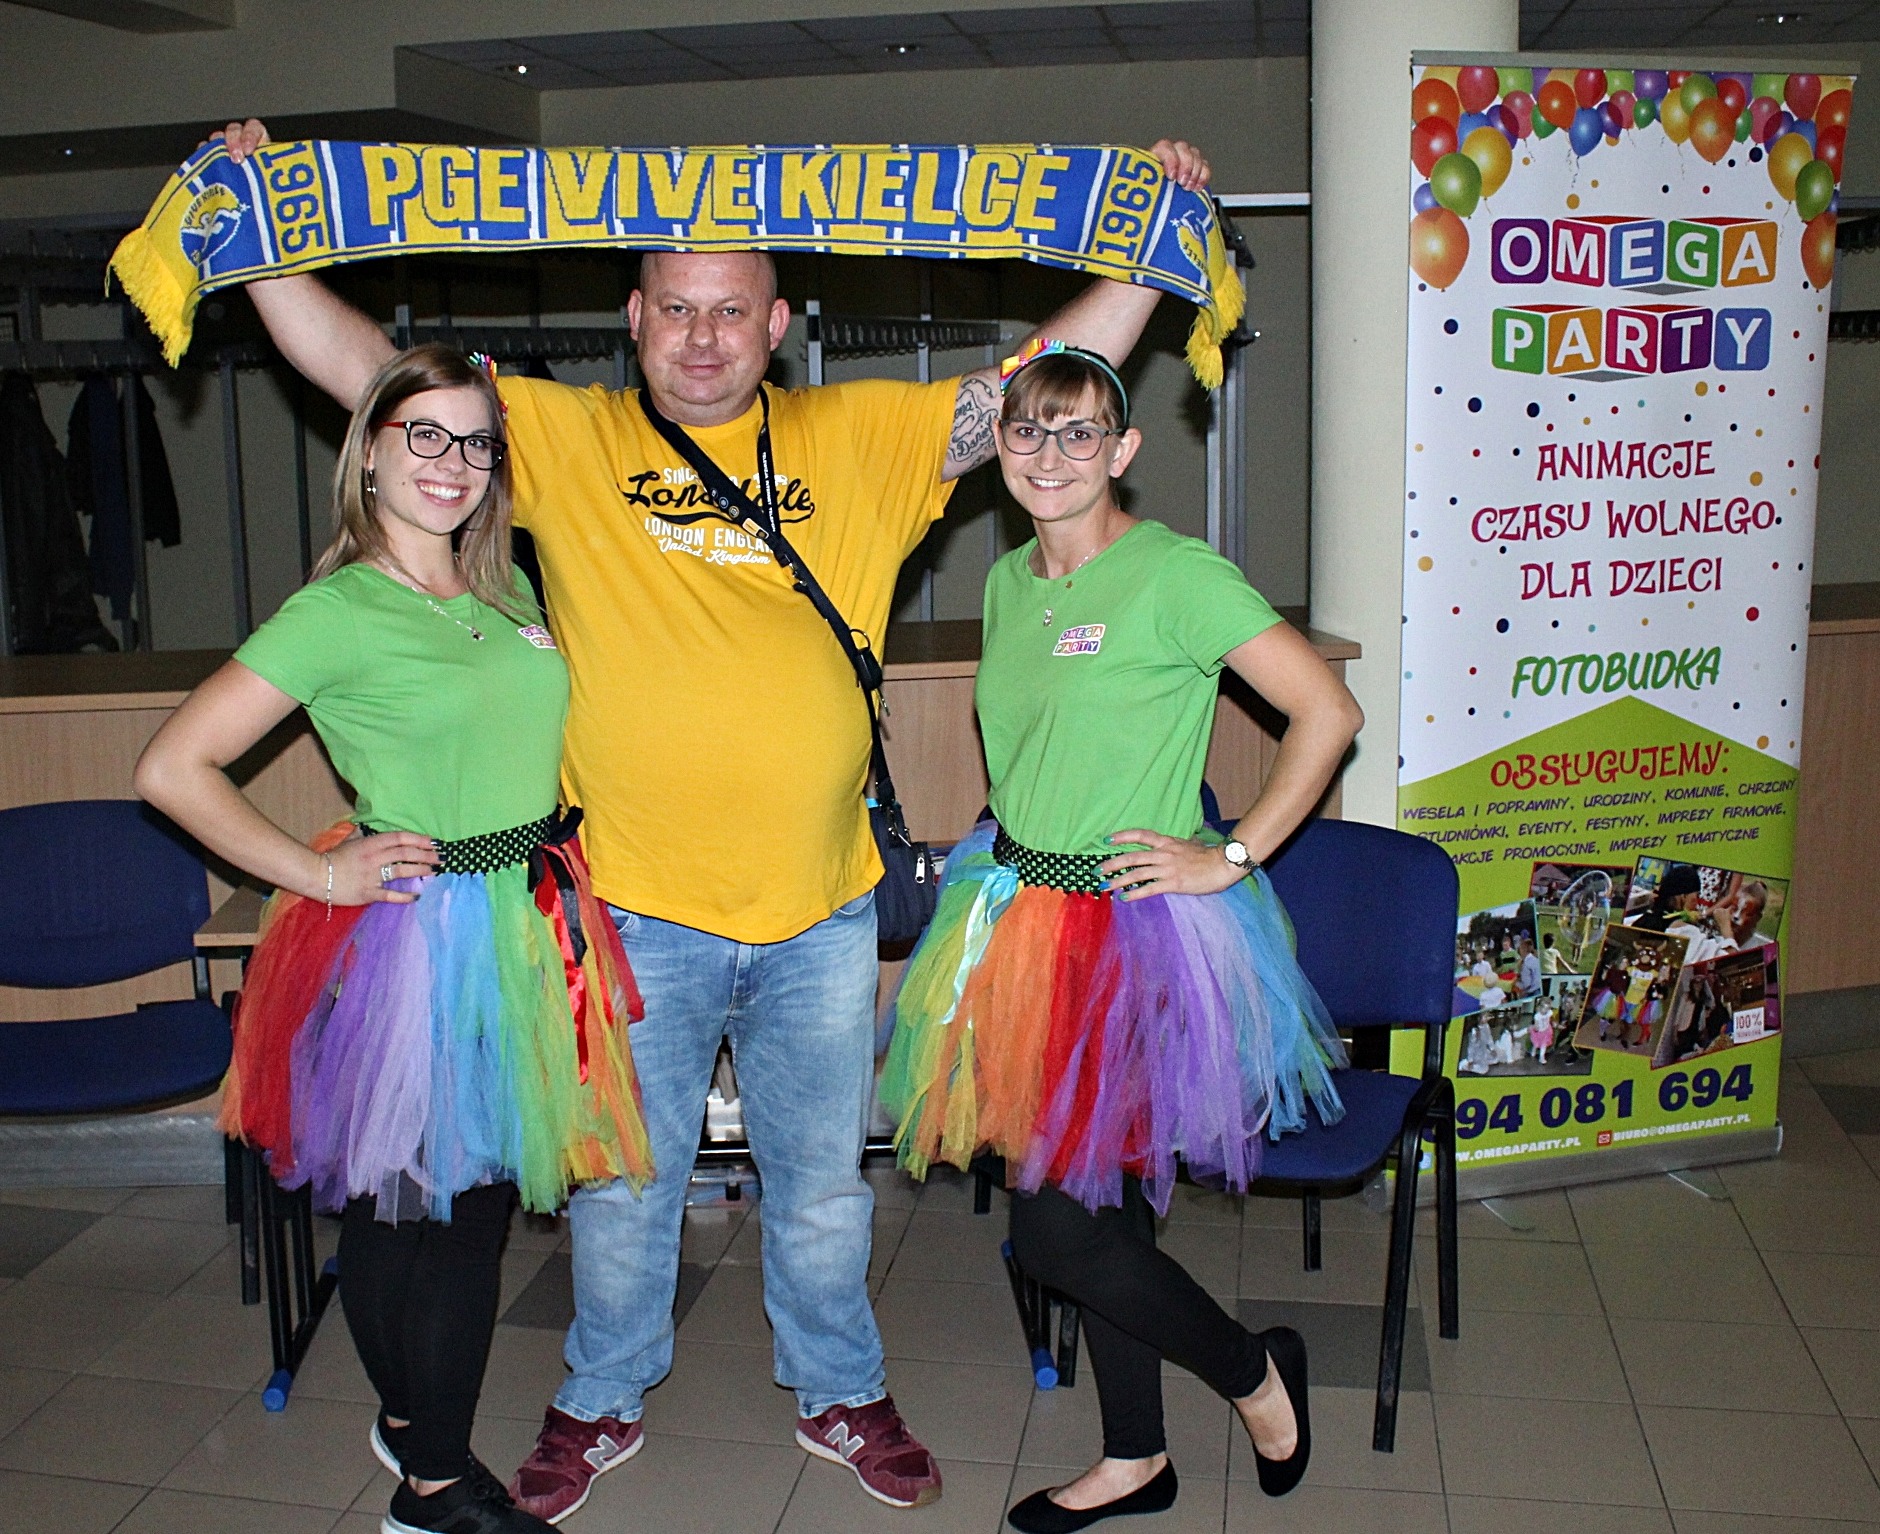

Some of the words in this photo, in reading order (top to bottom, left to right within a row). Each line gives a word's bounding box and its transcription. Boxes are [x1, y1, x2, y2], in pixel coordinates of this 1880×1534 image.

[259, 141, 325, 255] 1965
[361, 145, 530, 227] PGE
[544, 149, 759, 226] VIVE
[779, 151, 1071, 231] KIELCE
[1096, 153, 1158, 261] 1965
[1499, 226, 1770, 281] OMEGA
[1504, 315, 1764, 368] PARTY
[1536, 439, 1716, 482] ANIMACJE
[714, 527, 775, 554] ENGLA
[1471, 500, 1591, 543] CZASU
[1606, 496, 1775, 538] WOLNEGO
[657, 536, 703, 557] United
[705, 548, 771, 566] Kingdom
[1520, 560, 1592, 600] DLA
[1608, 556, 1723, 596] DZIECI
[1055, 640, 1098, 654] PARTY
[1061, 626, 1103, 641] OMEGA
[1511, 646, 1722, 699] FOTOBUDKA
[1490, 740, 1731, 791] OBSŁUGUJEMY:
[1403, 806, 1466, 821] WESELA
[1657, 807, 1715, 825] IMPREZY
[1609, 834, 1667, 853] IMPREZY
[1676, 826, 1760, 847] TEMATYCZNE
[1421, 1093, 1523, 1144] 94
[1539, 1078, 1635, 1130] 081
[1658, 1063, 1754, 1113] 694
